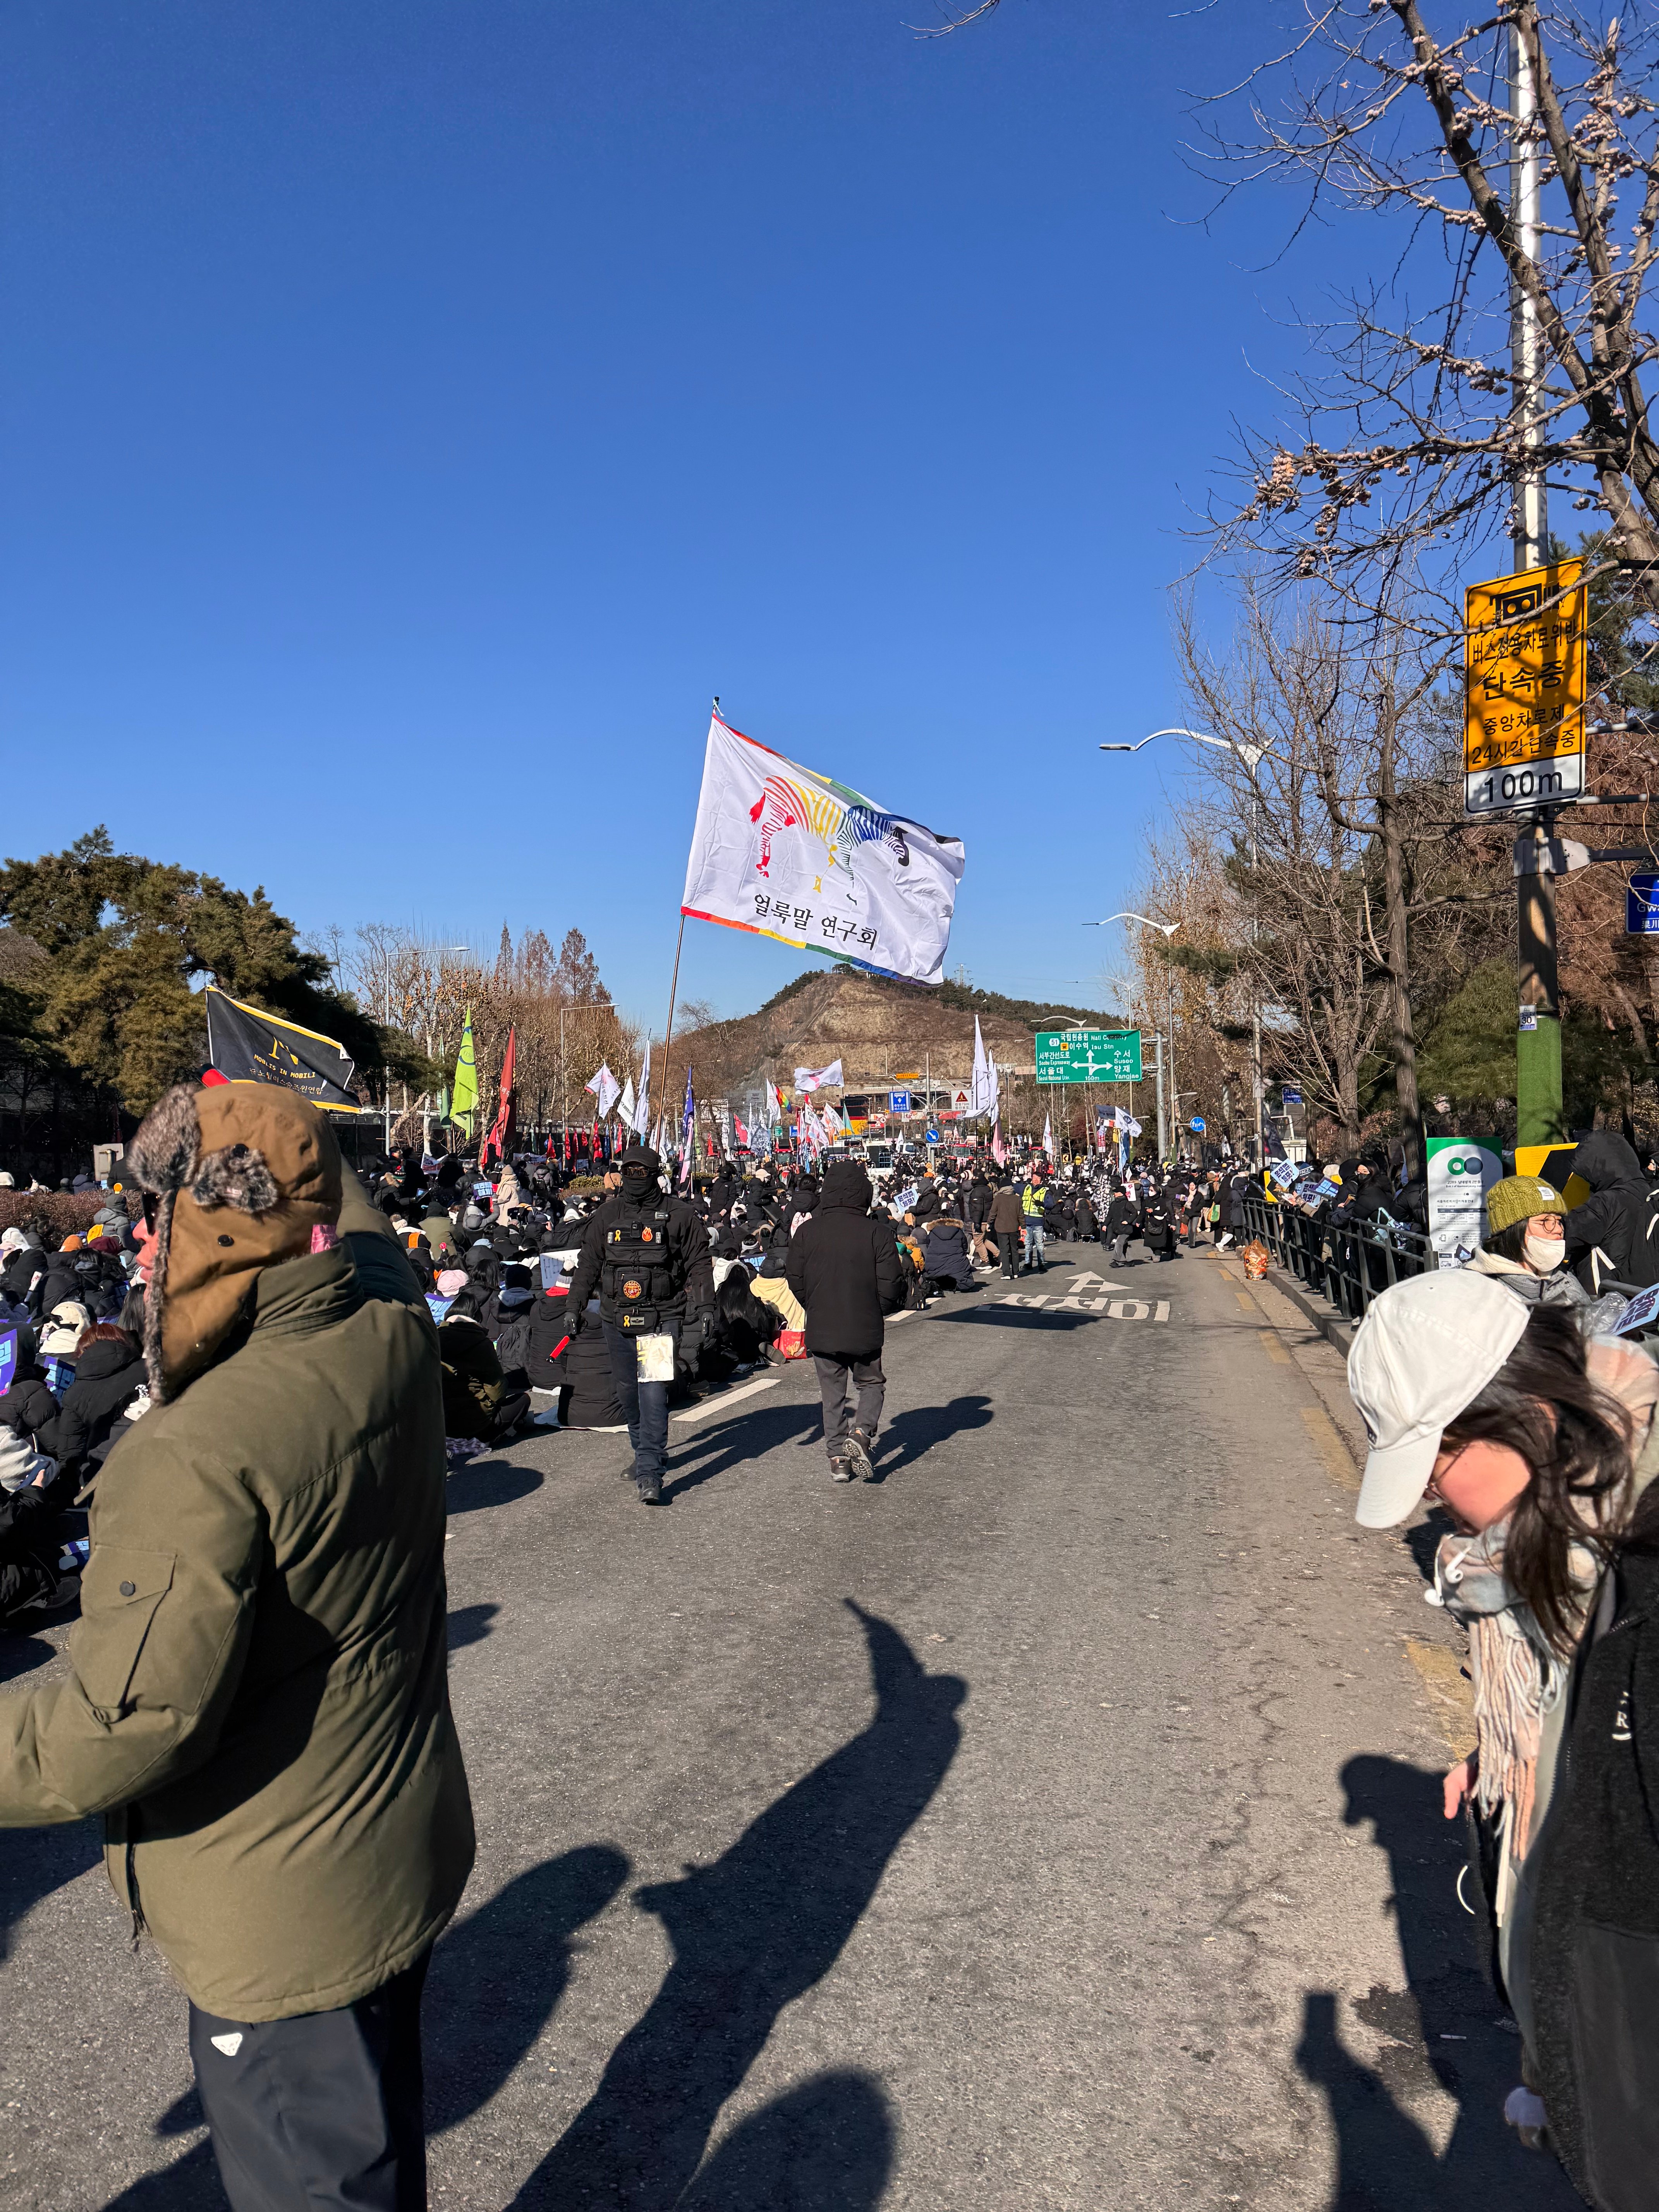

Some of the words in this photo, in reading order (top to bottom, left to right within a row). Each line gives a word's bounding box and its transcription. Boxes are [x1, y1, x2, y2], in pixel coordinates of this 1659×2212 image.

[1483, 659, 1565, 701] 단속중
[1483, 703, 1565, 735] 중앙차로제
[1484, 770, 1562, 802] 100m
[1637, 902, 1659, 912] Gw
[754, 893, 814, 931] 얼룩말
[821, 915, 878, 951] 연구회
[1069, 1042, 1089, 1050] 이수역
[1039, 1051, 1070, 1060] 서부간선도로
[1114, 1049, 1130, 1058] 수서
[1039, 1066, 1063, 1075] 서울대
[1114, 1065, 1130, 1073] 양재
[974, 1293, 1170, 1321] 천천히
